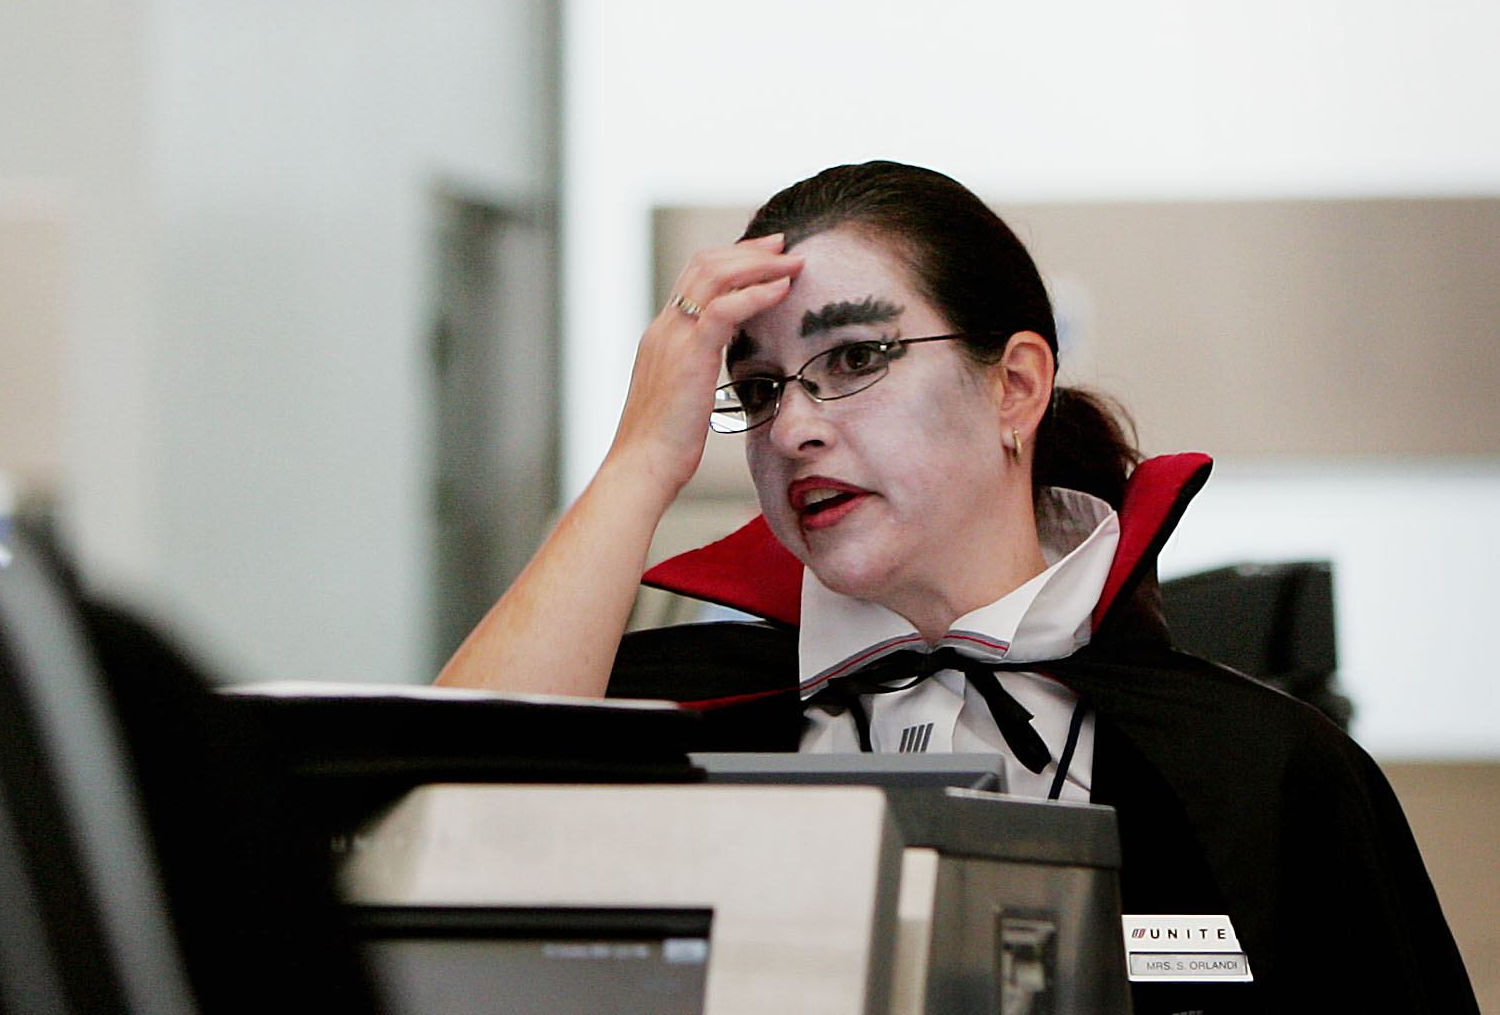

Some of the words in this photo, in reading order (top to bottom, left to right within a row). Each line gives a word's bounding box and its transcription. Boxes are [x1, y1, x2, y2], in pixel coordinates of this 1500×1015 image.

[1146, 961, 1174, 970] MRS.
[1176, 961, 1188, 970] S.
[1189, 960, 1238, 970] ORLANDI
